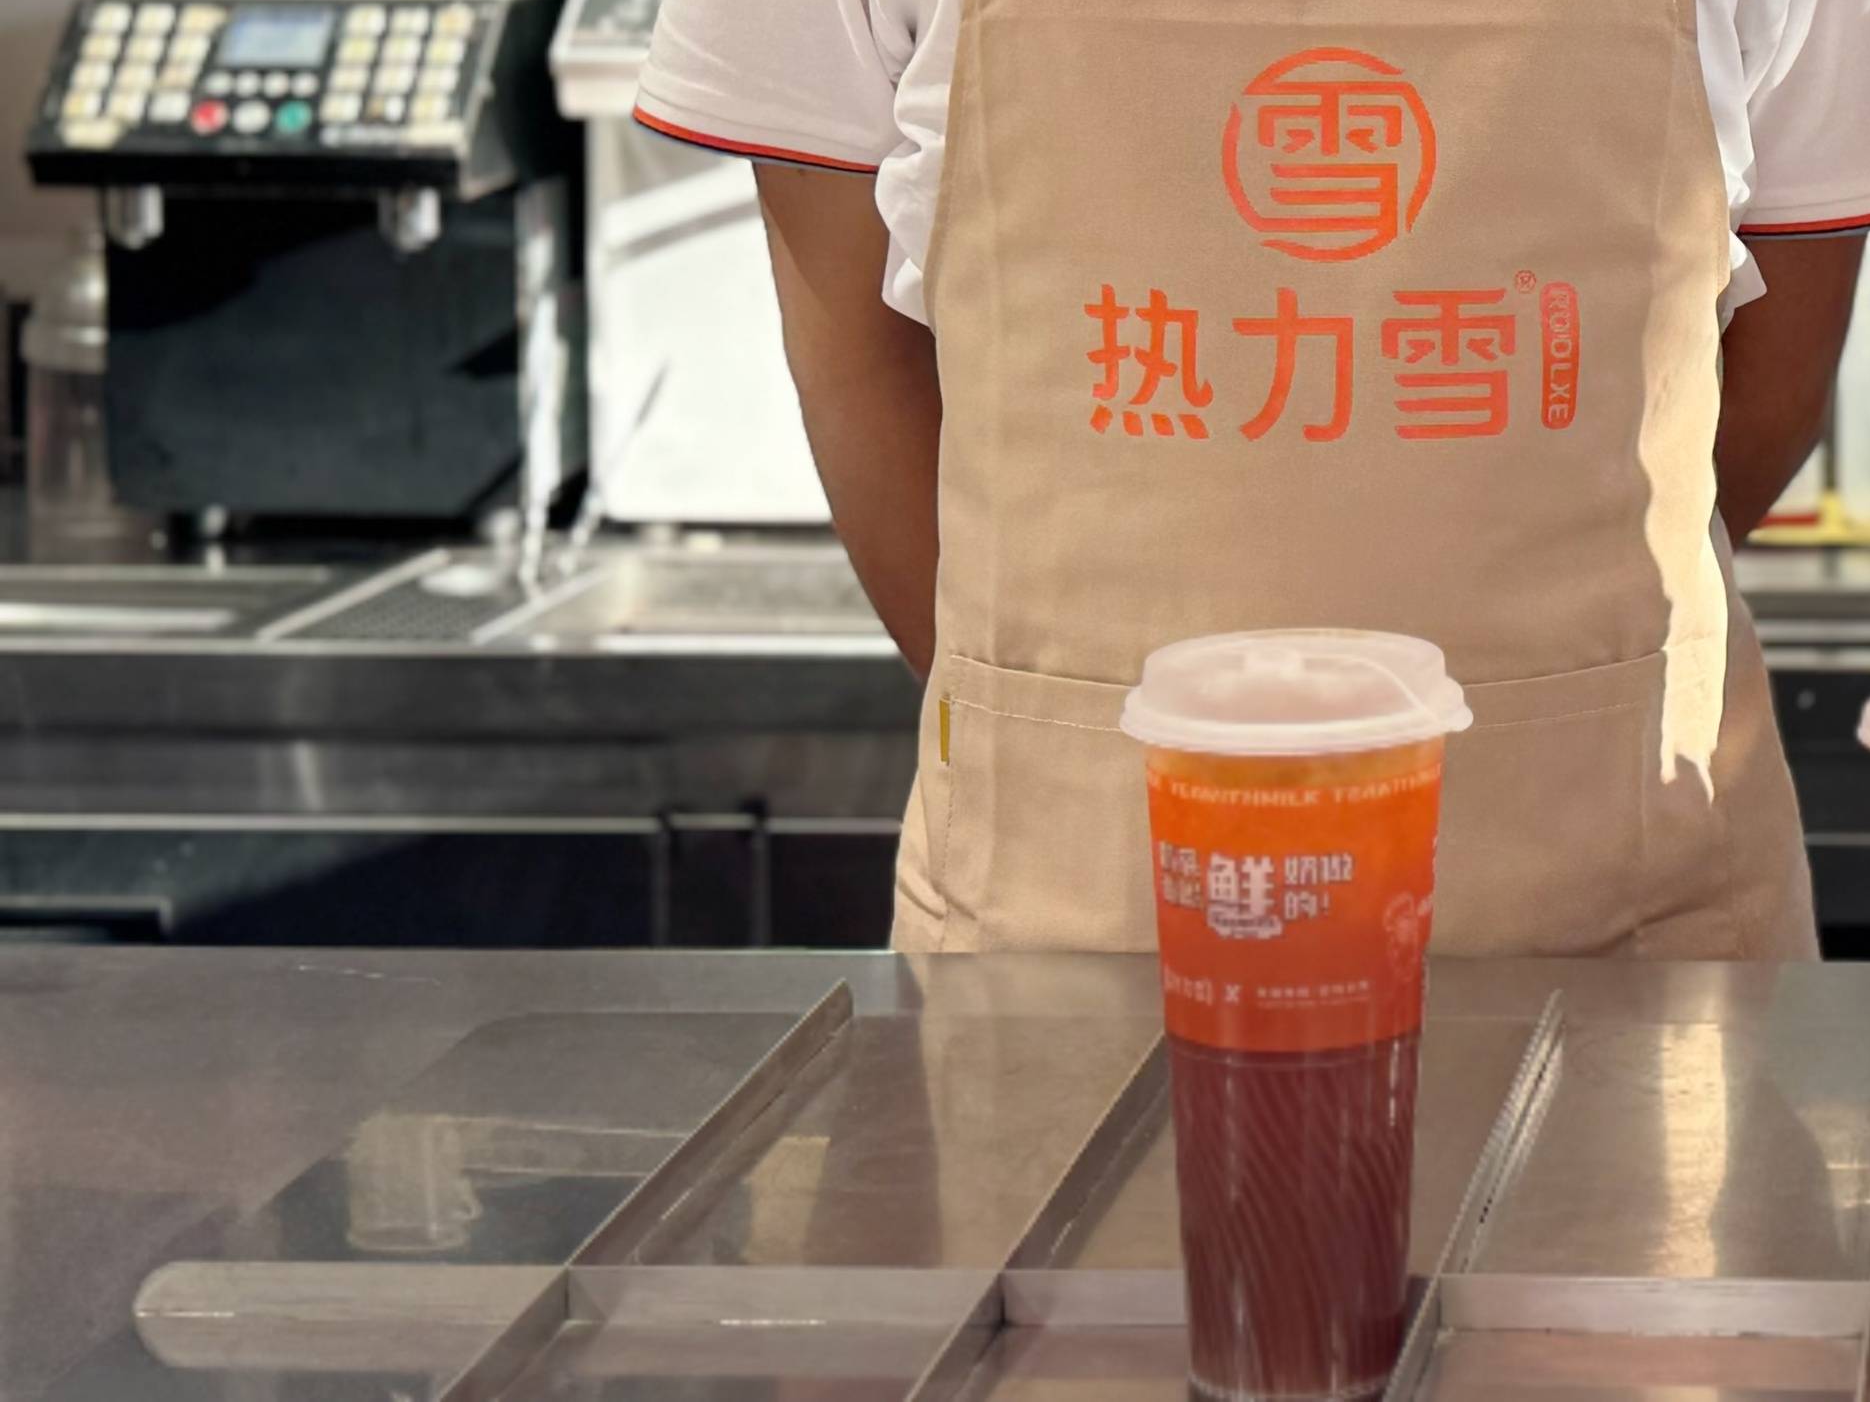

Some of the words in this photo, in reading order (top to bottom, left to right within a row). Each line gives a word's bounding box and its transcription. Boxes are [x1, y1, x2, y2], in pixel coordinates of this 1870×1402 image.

[1228, 56, 1431, 258] 雪
[1084, 283, 1518, 442] 热力雪
[1543, 285, 1577, 426] ROOLXE
